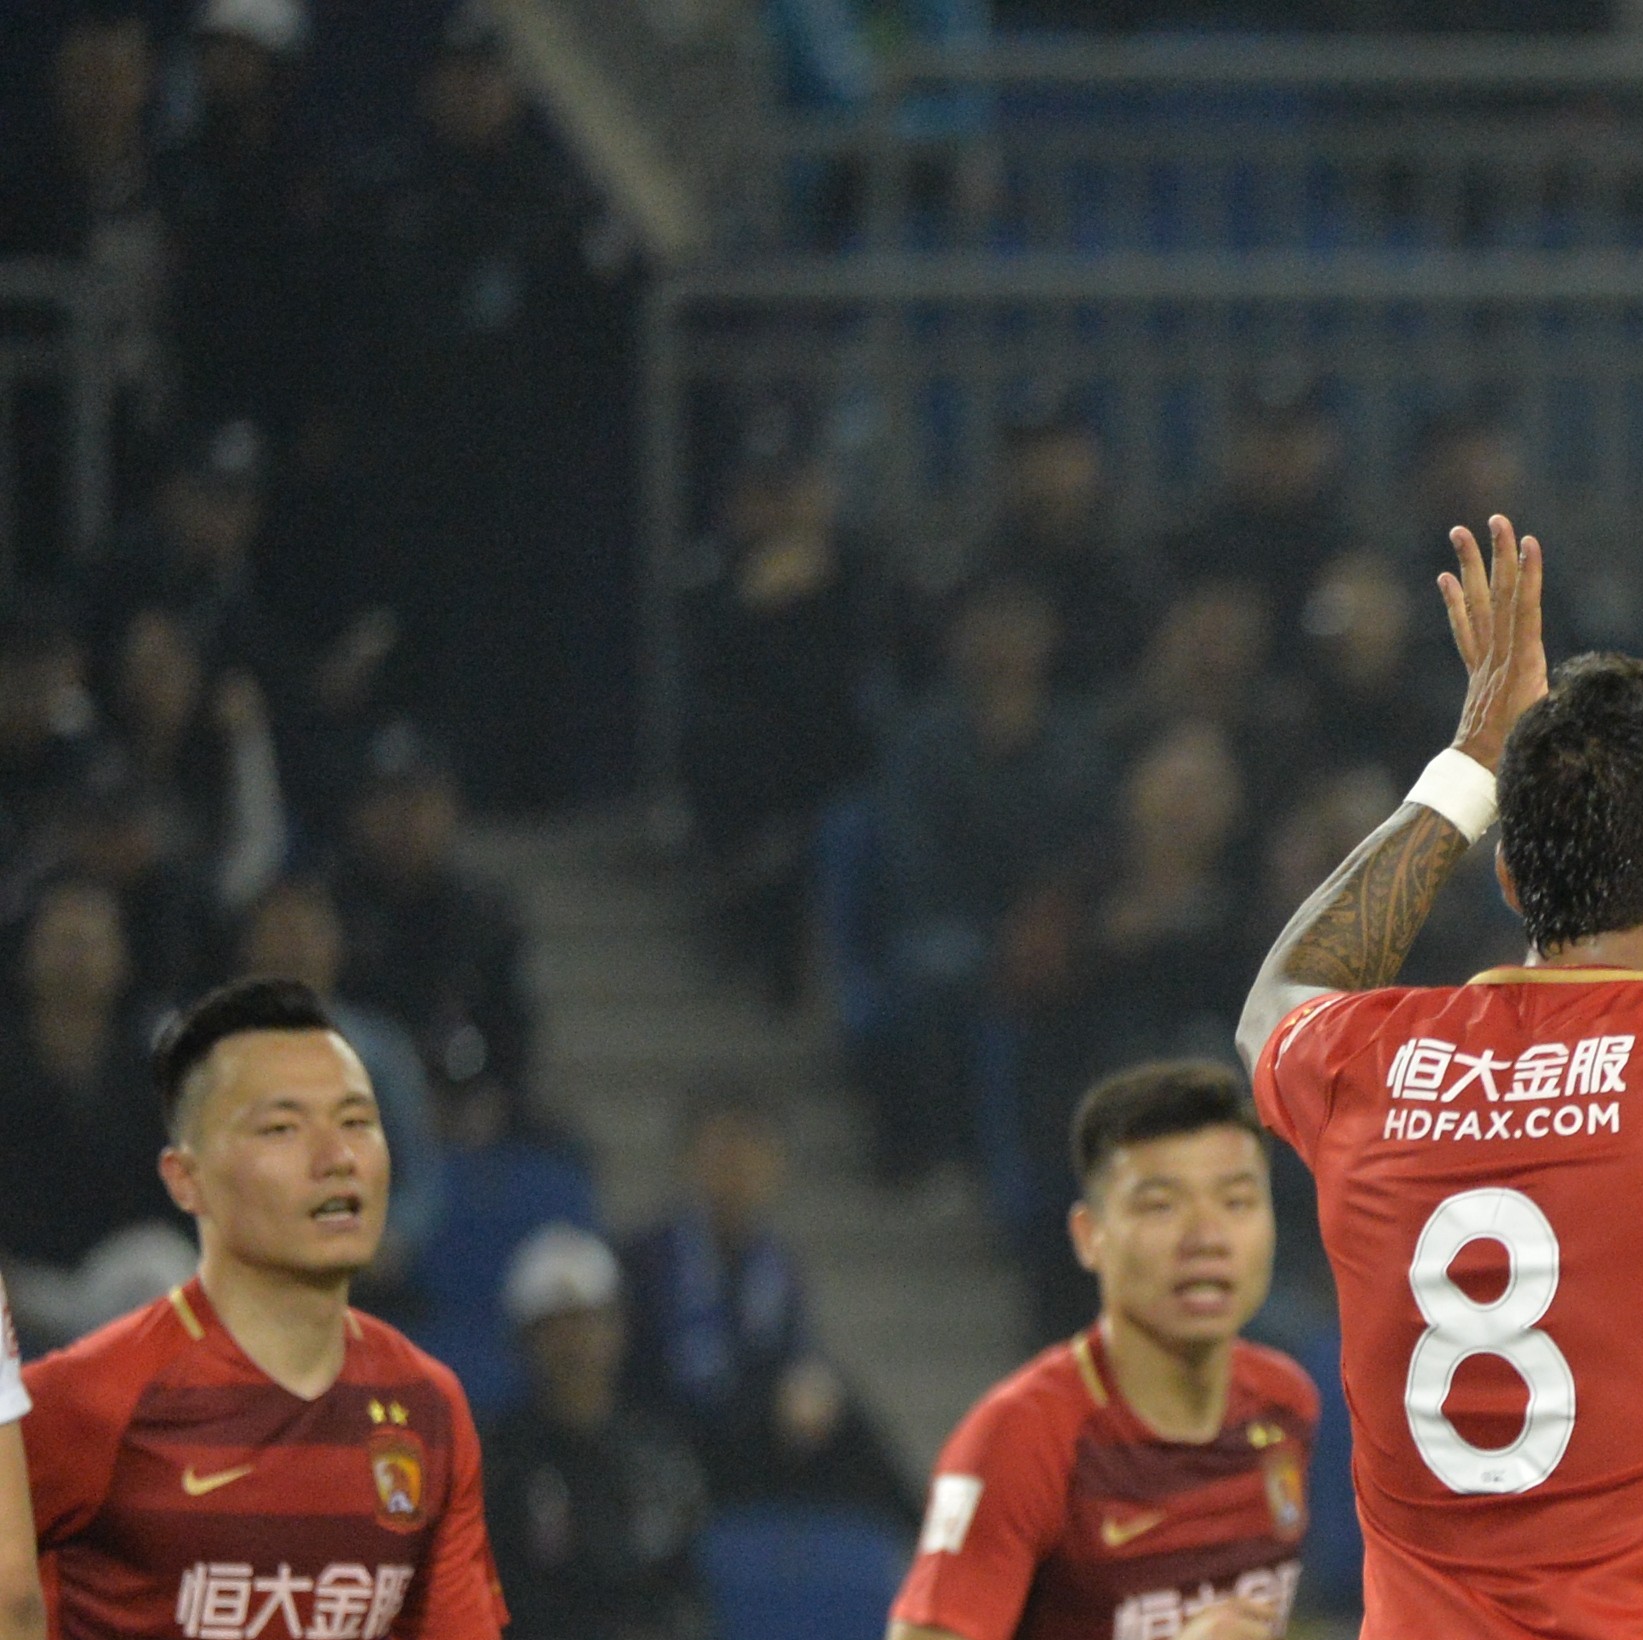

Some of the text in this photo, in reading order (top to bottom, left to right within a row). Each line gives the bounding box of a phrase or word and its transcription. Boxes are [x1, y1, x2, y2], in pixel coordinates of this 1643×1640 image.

[1386, 1035, 1636, 1102] 恒大金服
[1383, 1102, 1621, 1141] HDFAX.COM
[1405, 1187, 1575, 1494] 8
